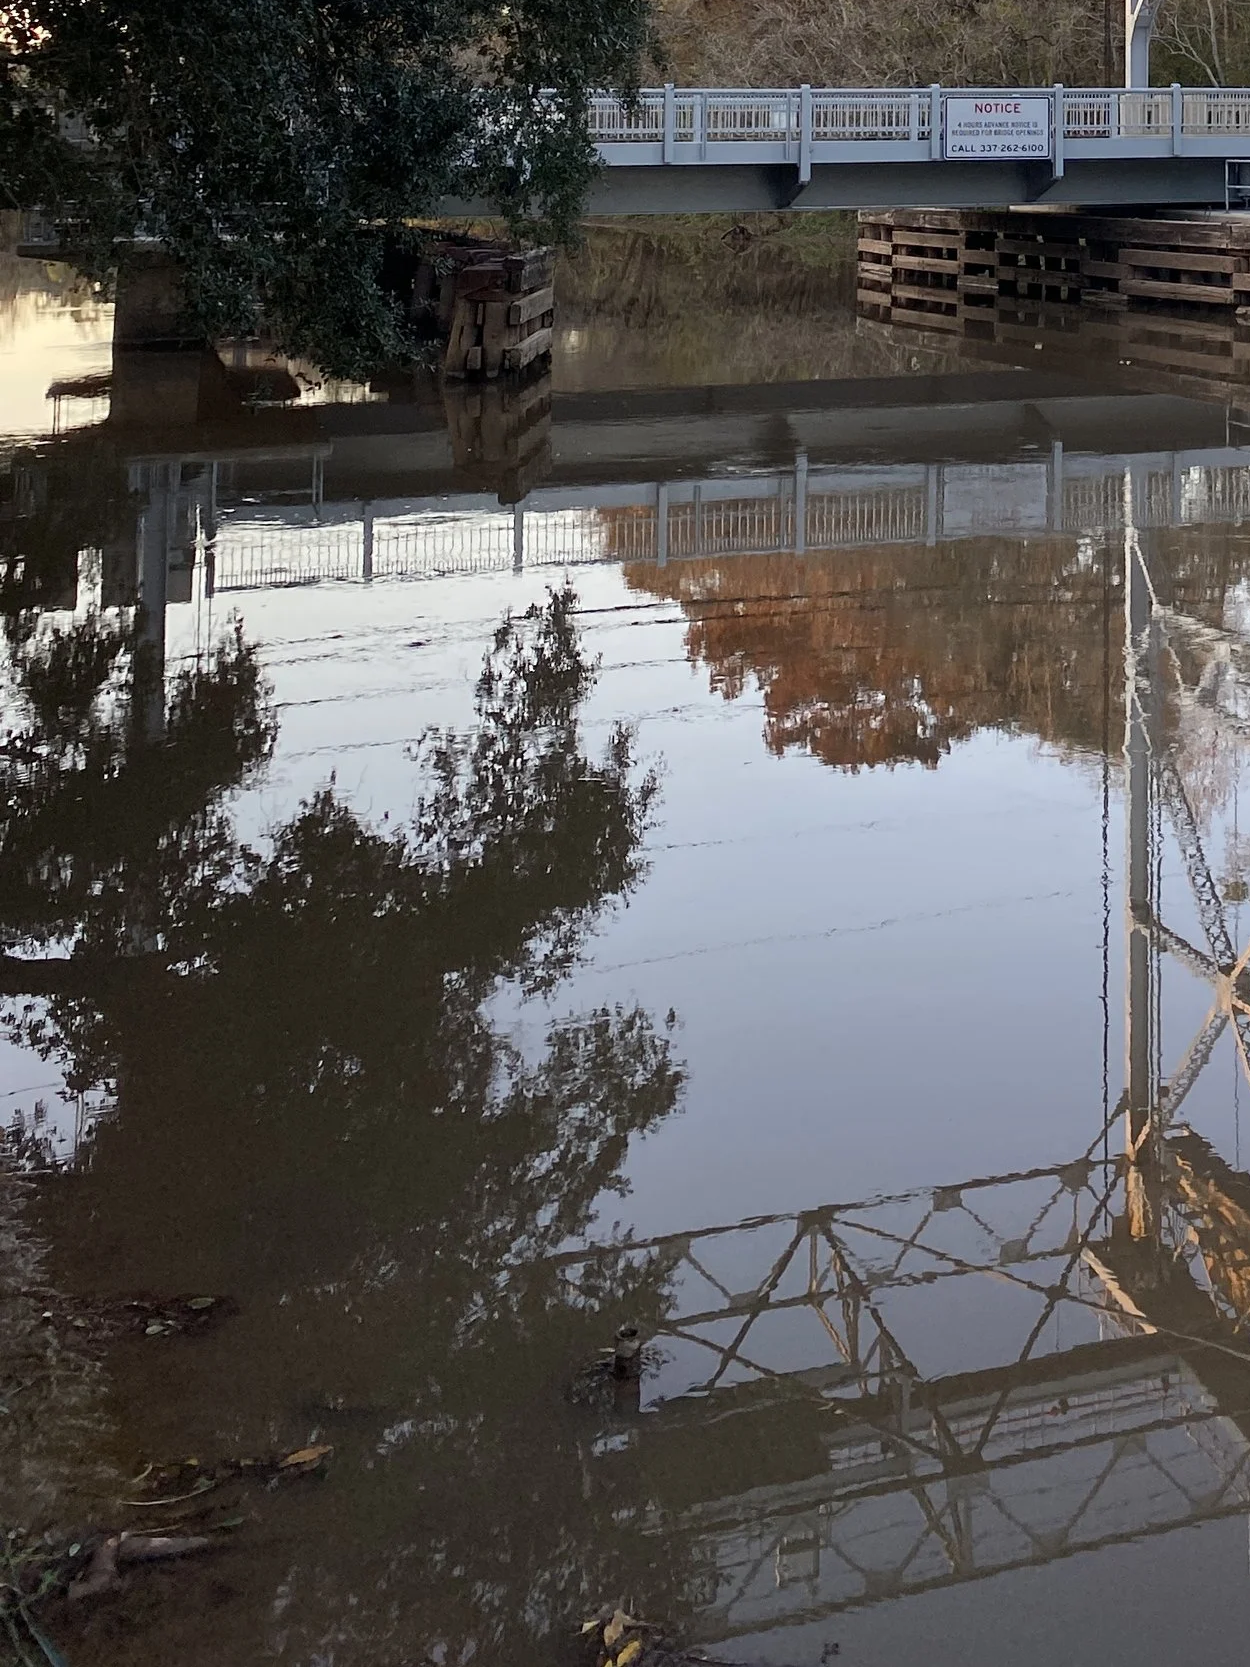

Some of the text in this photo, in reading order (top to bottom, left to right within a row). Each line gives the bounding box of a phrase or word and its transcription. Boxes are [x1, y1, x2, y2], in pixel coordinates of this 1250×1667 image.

[974, 103, 1021, 114] NOTICE
[951, 144, 1044, 153] CALL 337-262-6100
